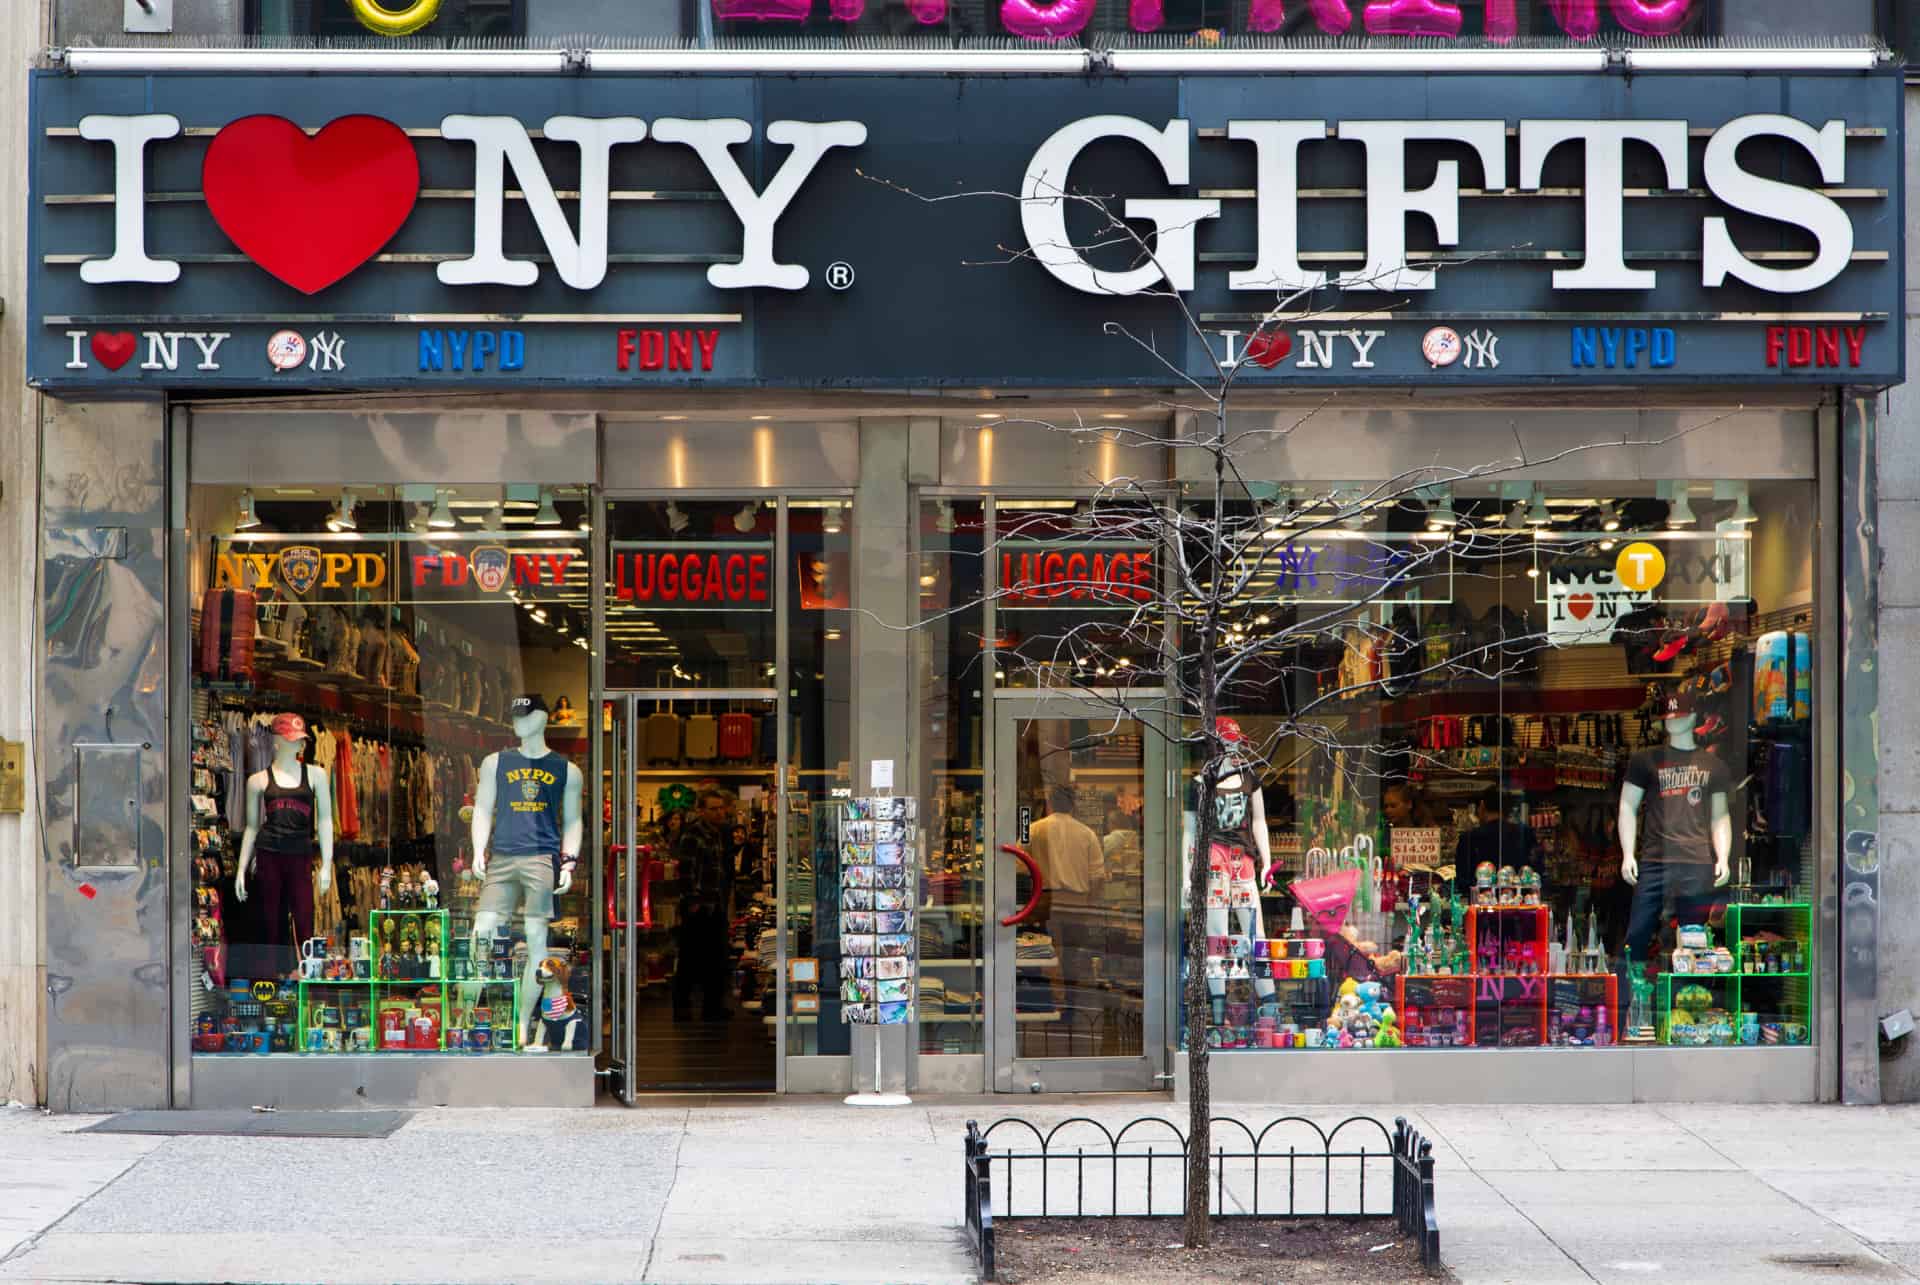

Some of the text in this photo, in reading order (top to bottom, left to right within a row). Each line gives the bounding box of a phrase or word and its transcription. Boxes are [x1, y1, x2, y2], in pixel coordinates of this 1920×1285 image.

[79, 114, 181, 284] I
[436, 115, 868, 290] NY
[1020, 114, 1855, 295] GIFTS
[65, 330, 88, 370] I
[141, 330, 231, 370] NY
[419, 329, 525, 372] NYPD
[616, 329, 721, 372] FDNY
[1218, 329, 1241, 368] I
[1295, 329, 1386, 369] NY
[1571, 327, 1677, 368] NYPD
[1766, 325, 1867, 368] FDNY
[616, 552, 768, 601] LUGGAGE
[1002, 550, 1152, 601] LUGGAGE
[1552, 593, 1566, 621] I
[506, 767, 557, 785] NYPD
